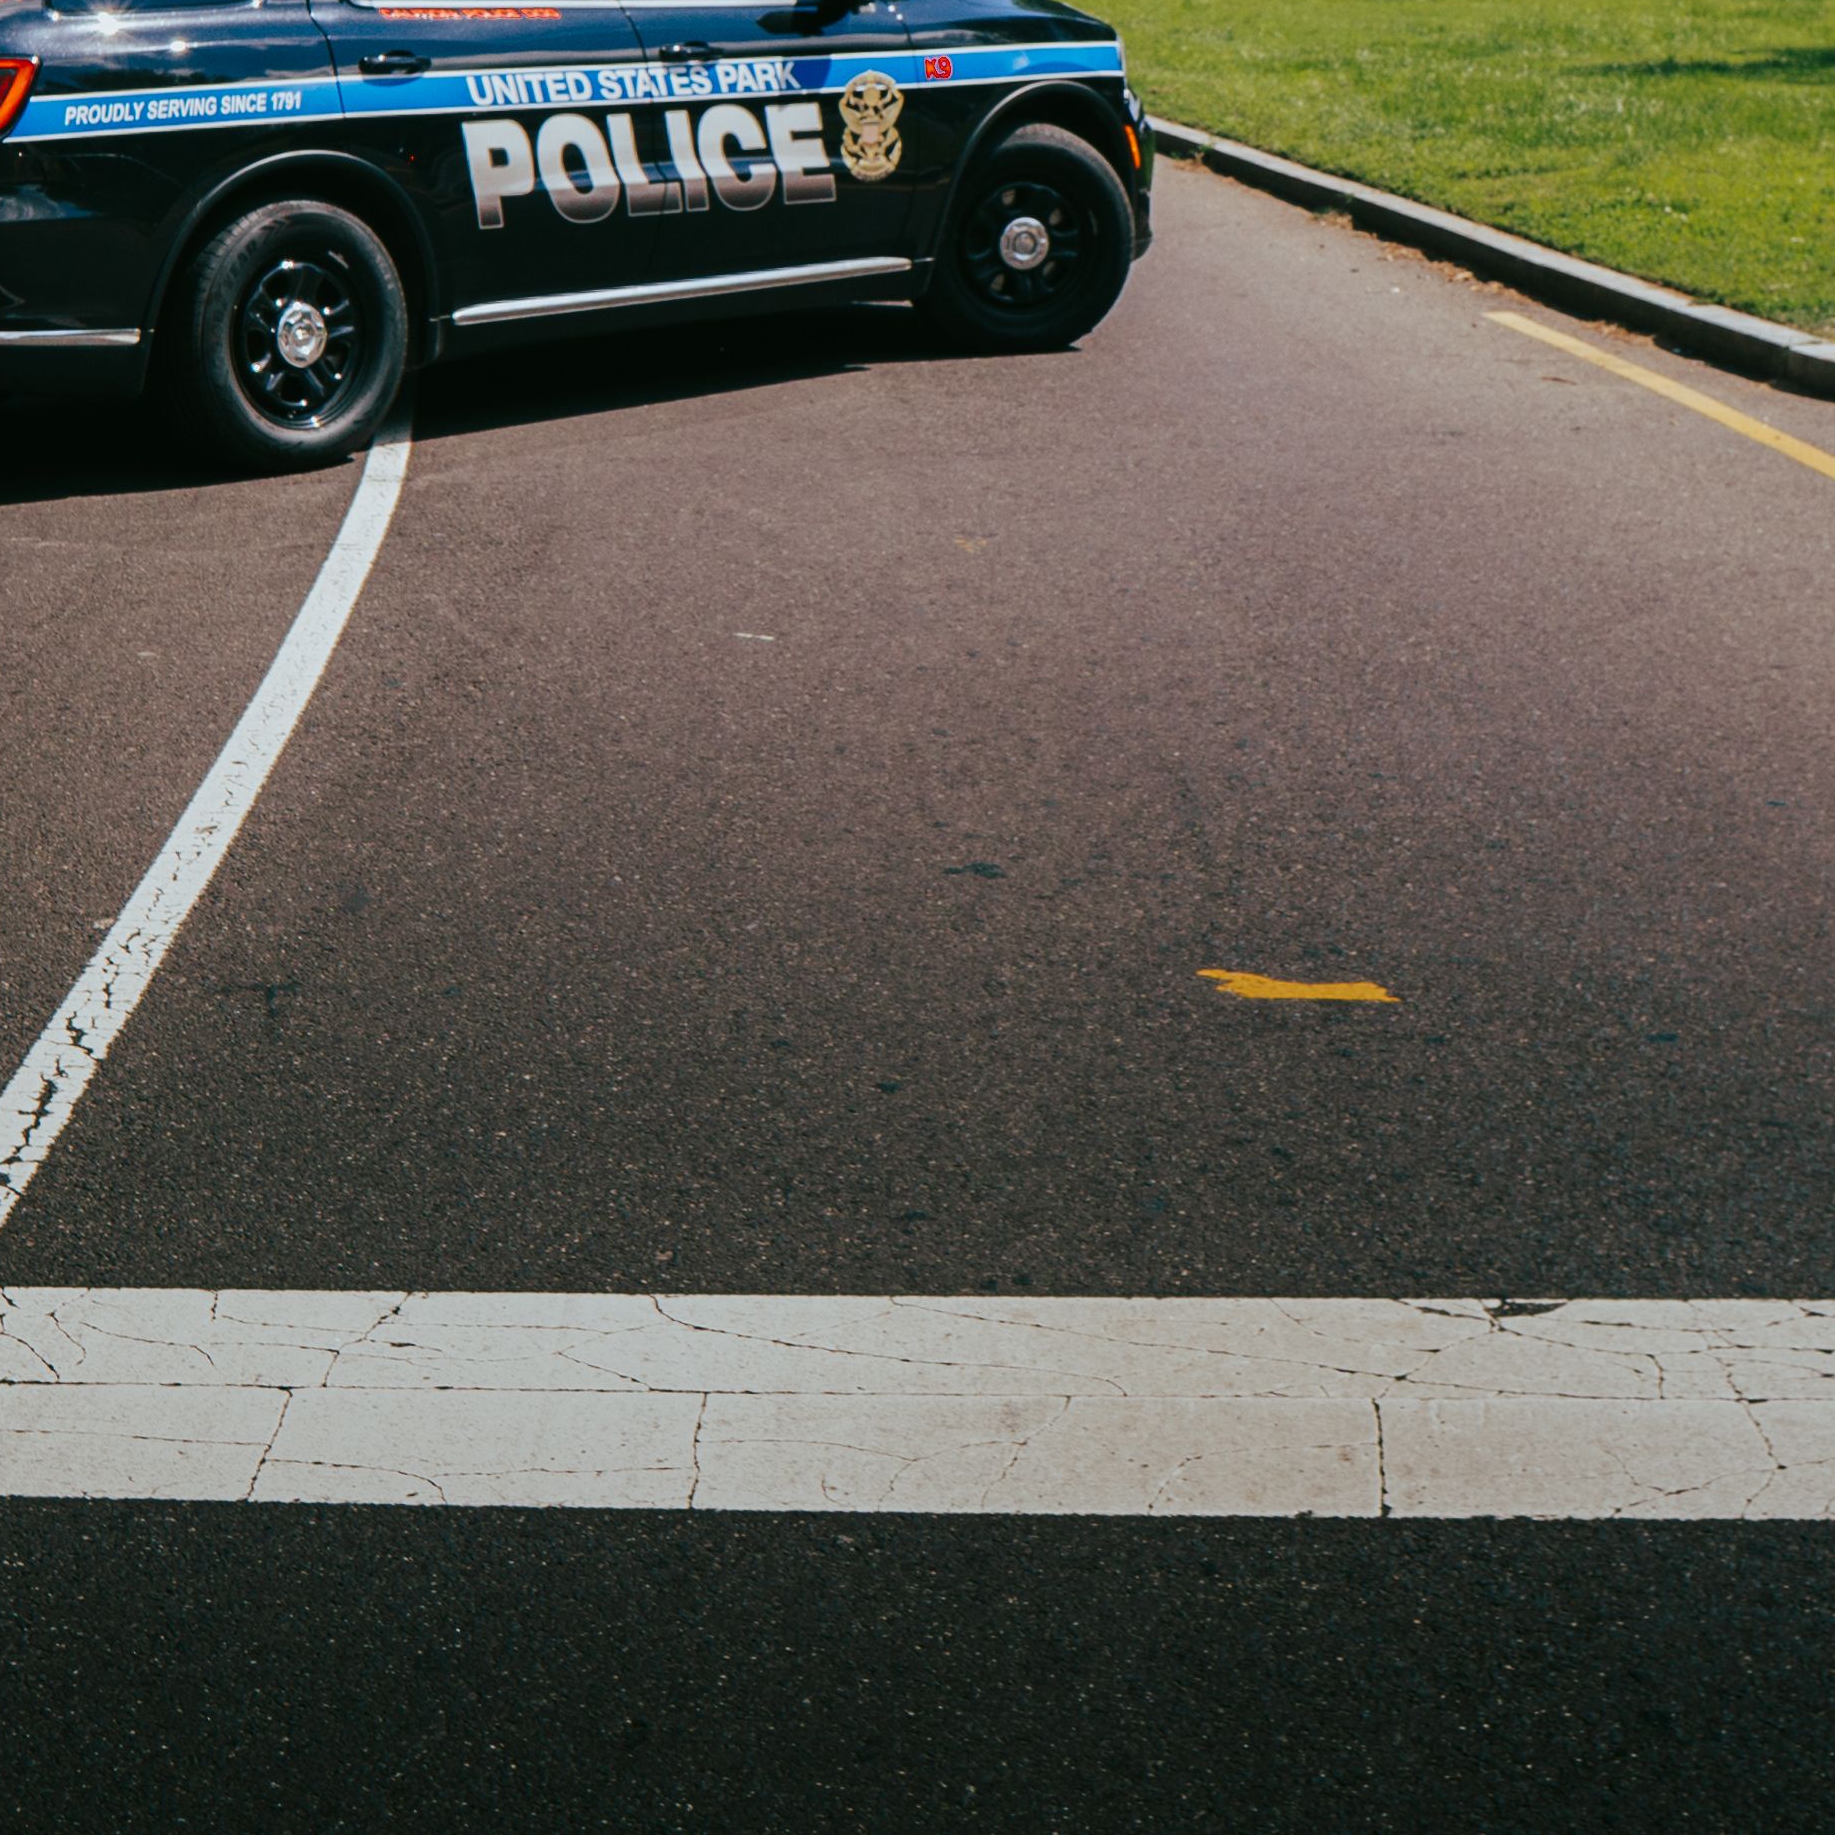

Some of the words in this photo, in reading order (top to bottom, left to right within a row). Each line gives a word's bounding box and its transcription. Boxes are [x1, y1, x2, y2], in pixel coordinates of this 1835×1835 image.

[466, 70, 593, 107] UNITED
[599, 65, 714, 101] STATES
[717, 61, 801, 94] PARK
[924, 55, 953, 80] K9
[65, 101, 144, 126] PROUDLY
[147, 96, 217, 120] SERVING
[220, 92, 267, 115] SINCE
[271, 90, 302, 111] 1791
[462, 103, 836, 229] POLICE
